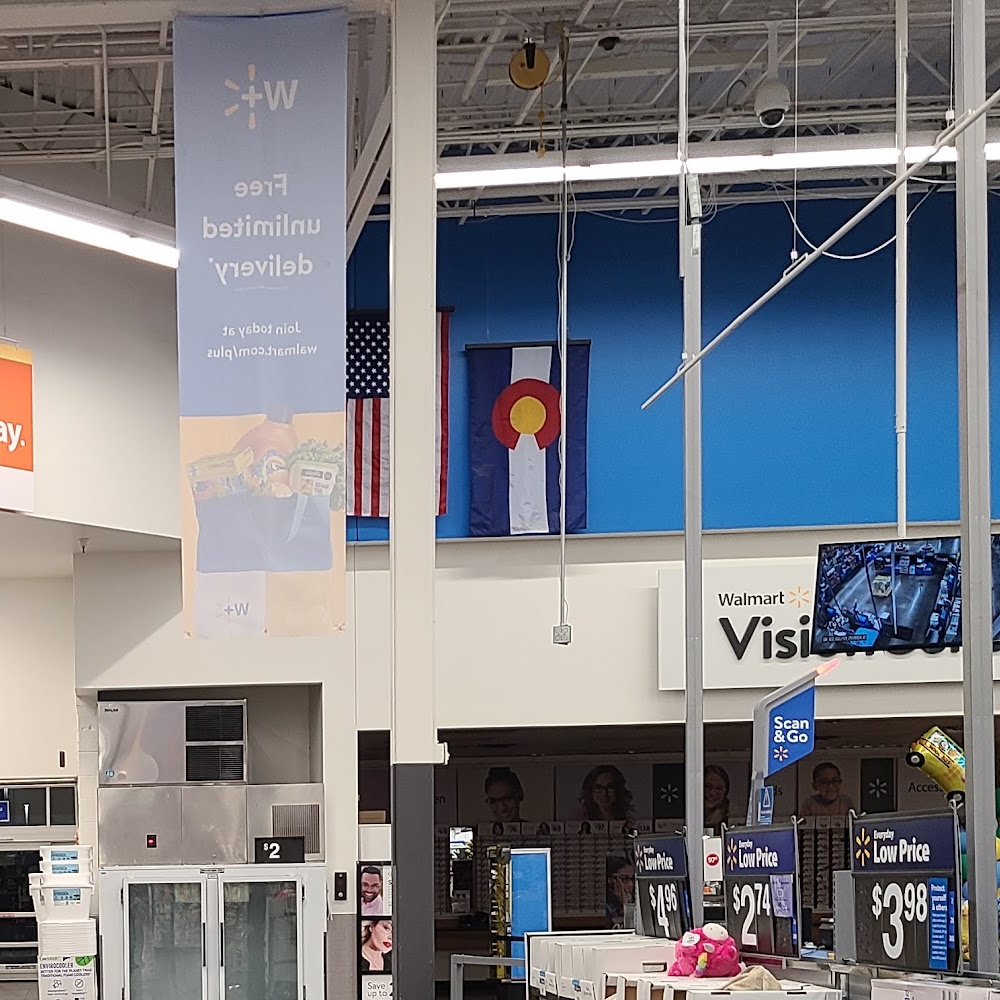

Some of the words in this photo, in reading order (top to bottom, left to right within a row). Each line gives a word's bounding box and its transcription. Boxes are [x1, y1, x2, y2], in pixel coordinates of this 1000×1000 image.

[718, 591, 785, 607] Walmart
[773, 716, 810, 730] Scan
[874, 829, 895, 841] Everyday
[263, 842, 281, 859] $2
[738, 849, 756, 868] Low
[756, 846, 778, 868] Price
[873, 840, 898, 863] Low
[899, 837, 930, 862] Price
[644, 853, 657, 871] Low
[656, 852, 674, 871] Price
[367, 981, 386, 990] Save
[367, 991, 377, 999] up
